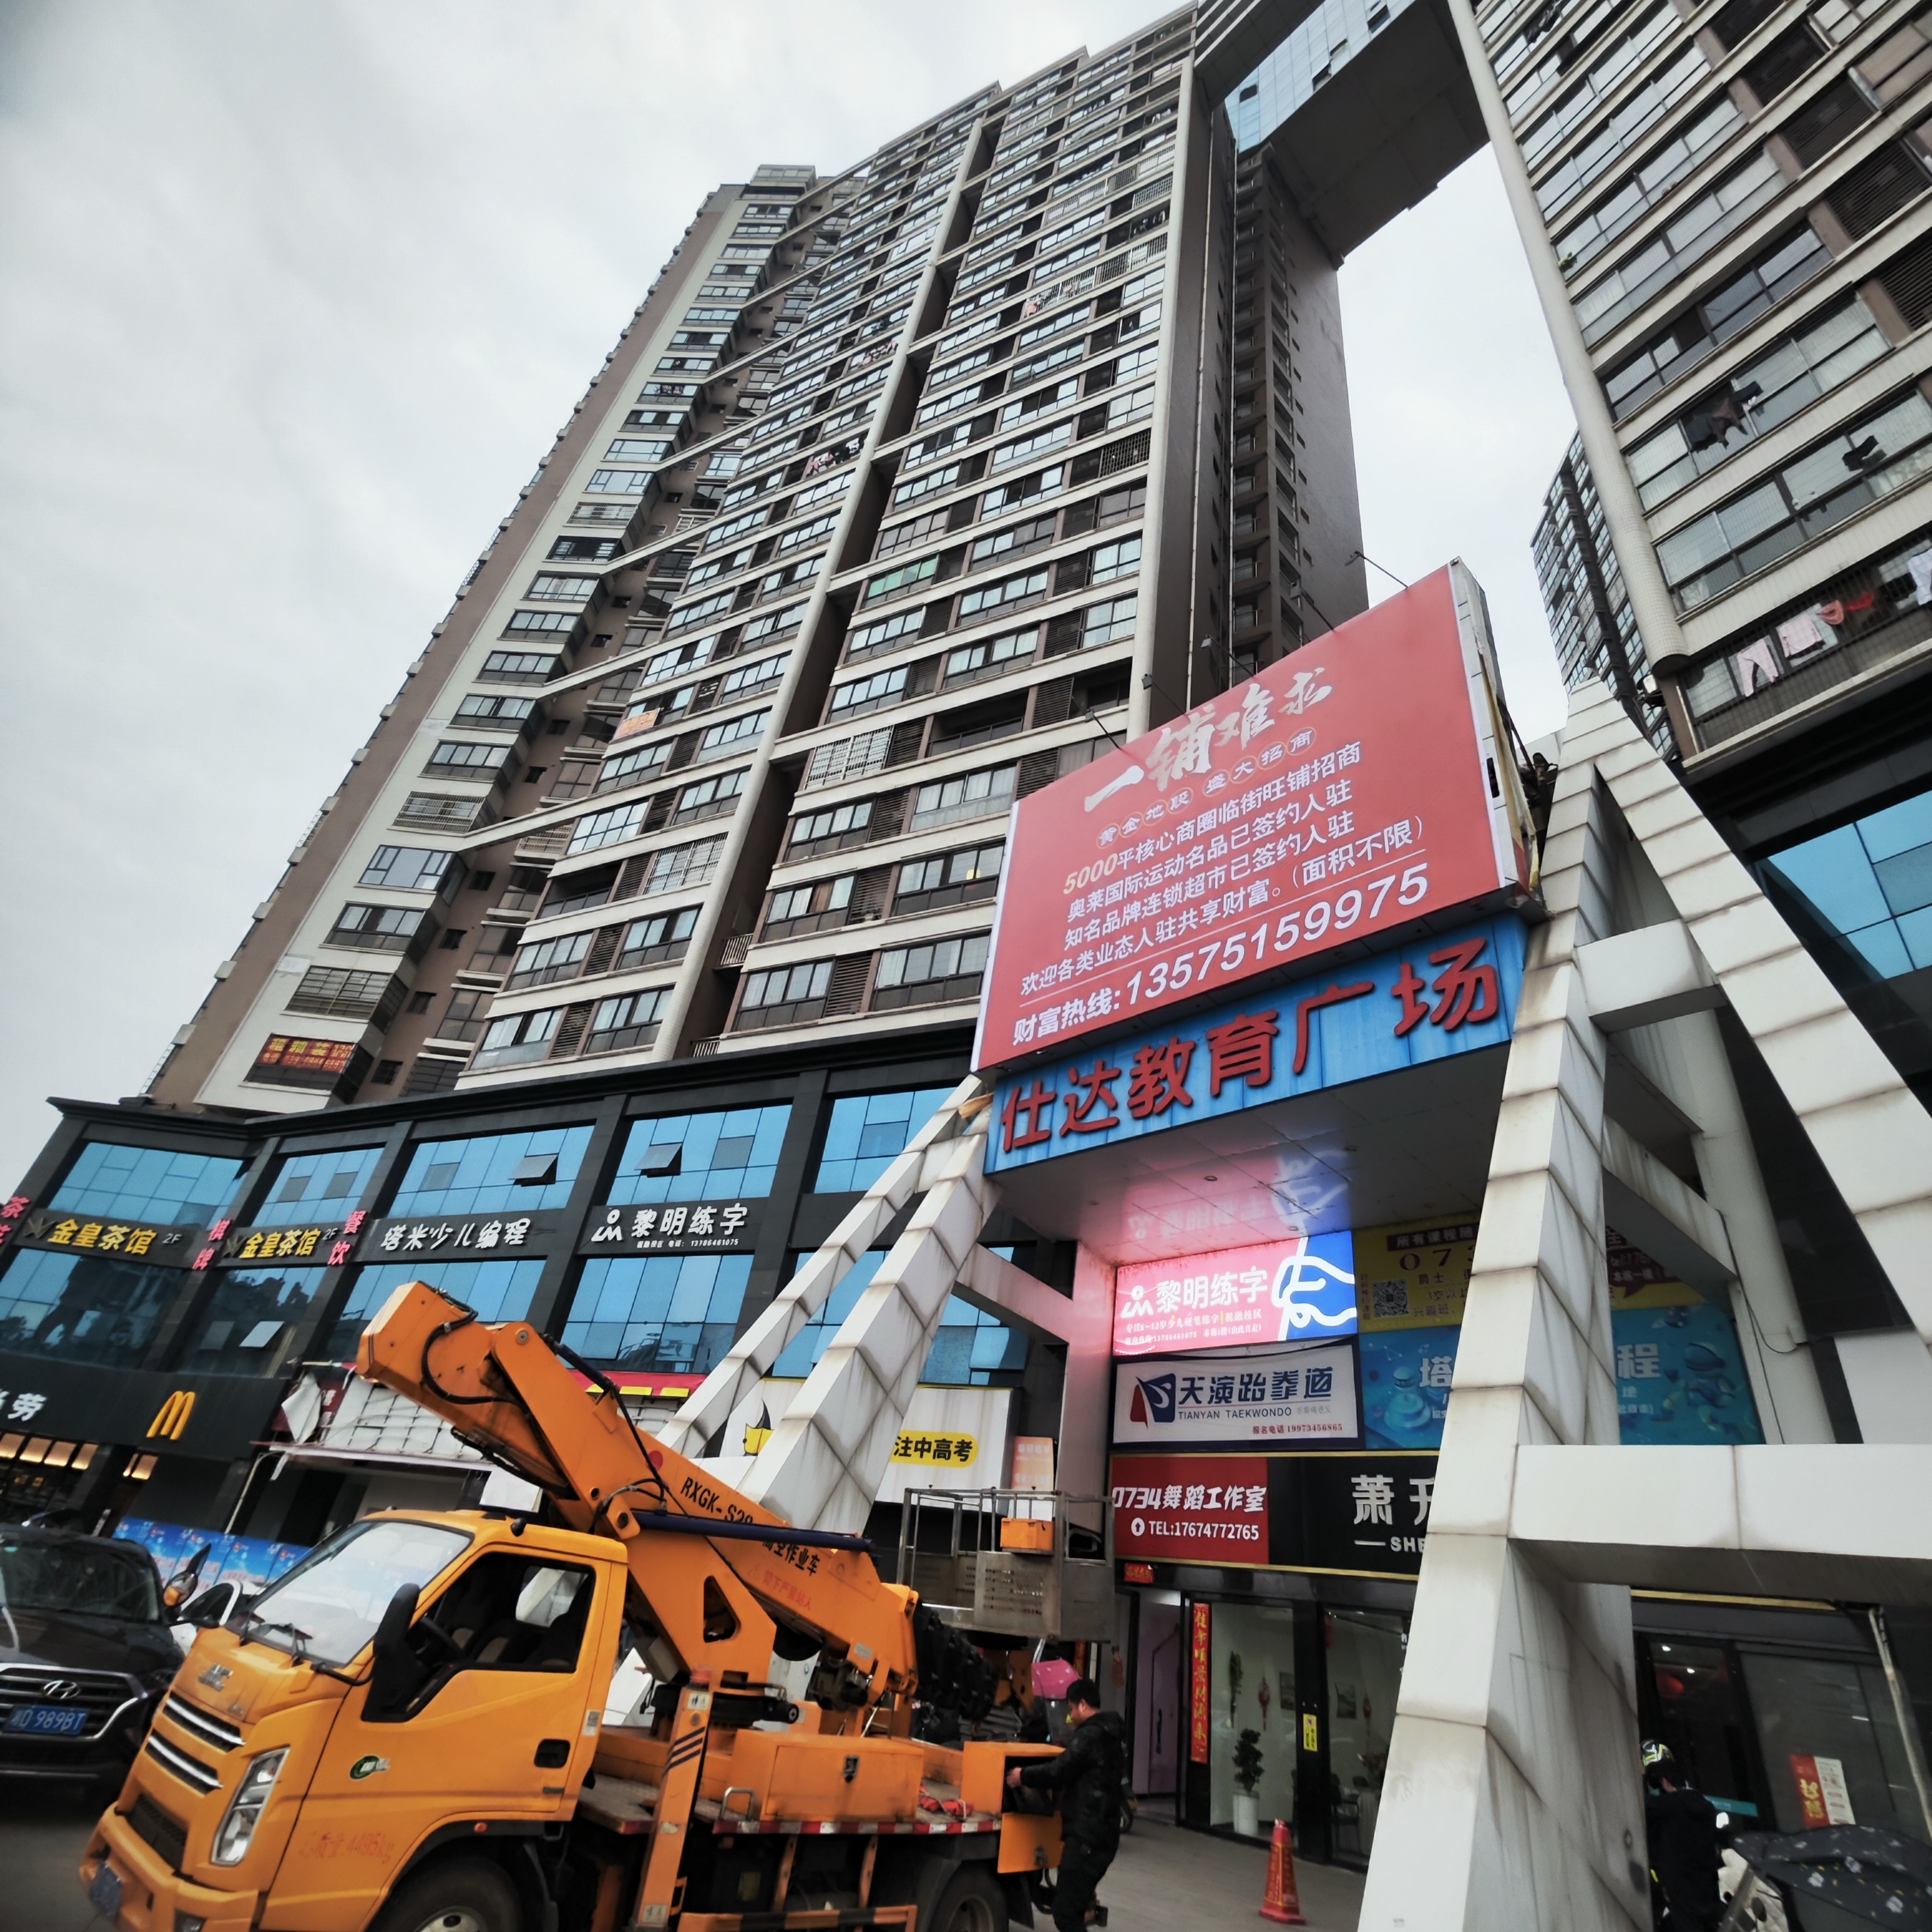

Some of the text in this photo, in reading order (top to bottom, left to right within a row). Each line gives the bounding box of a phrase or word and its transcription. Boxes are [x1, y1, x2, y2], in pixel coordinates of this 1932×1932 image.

[1084, 667, 1332, 812] 一铺难求
[1099, 730, 1313, 846] 黄金地段 盛大招商
[1063, 741, 1361, 894] 5000平核心商圈临街旺铺招商
[1067, 779, 1353, 923] 奥莱国际运动名品已签约入驻
[1064, 810, 1355, 950] 知名品牌连锁超市已签约入驻
[1001, 936, 1499, 1153] 仕达教育广场
[47, 1218, 183, 1255] 金皇茶馆 2F
[380, 1218, 531, 1251] 塔米少儿编程
[631, 1202, 748, 1238] 黎明练字
[239, 1228, 338, 1258] 金皇茶馆 2F
[1156, 1266, 1268, 1313] 黎明练字
[1617, 1343, 1661, 1379] 程
[1179, 1367, 1333, 1405] 天演跆拳道
[1179, 1410, 1220, 1420] TIANYAN
[1225, 1407, 1292, 1419] TAEKWONDO
[1253, 1424, 1284, 1435] 报名电话
[894, 1436, 973, 1462] 注中高考
[1113, 1484, 1267, 1513] 0734舞蹈工作室
[1148, 1521, 1259, 1540] TEL:17674772765
